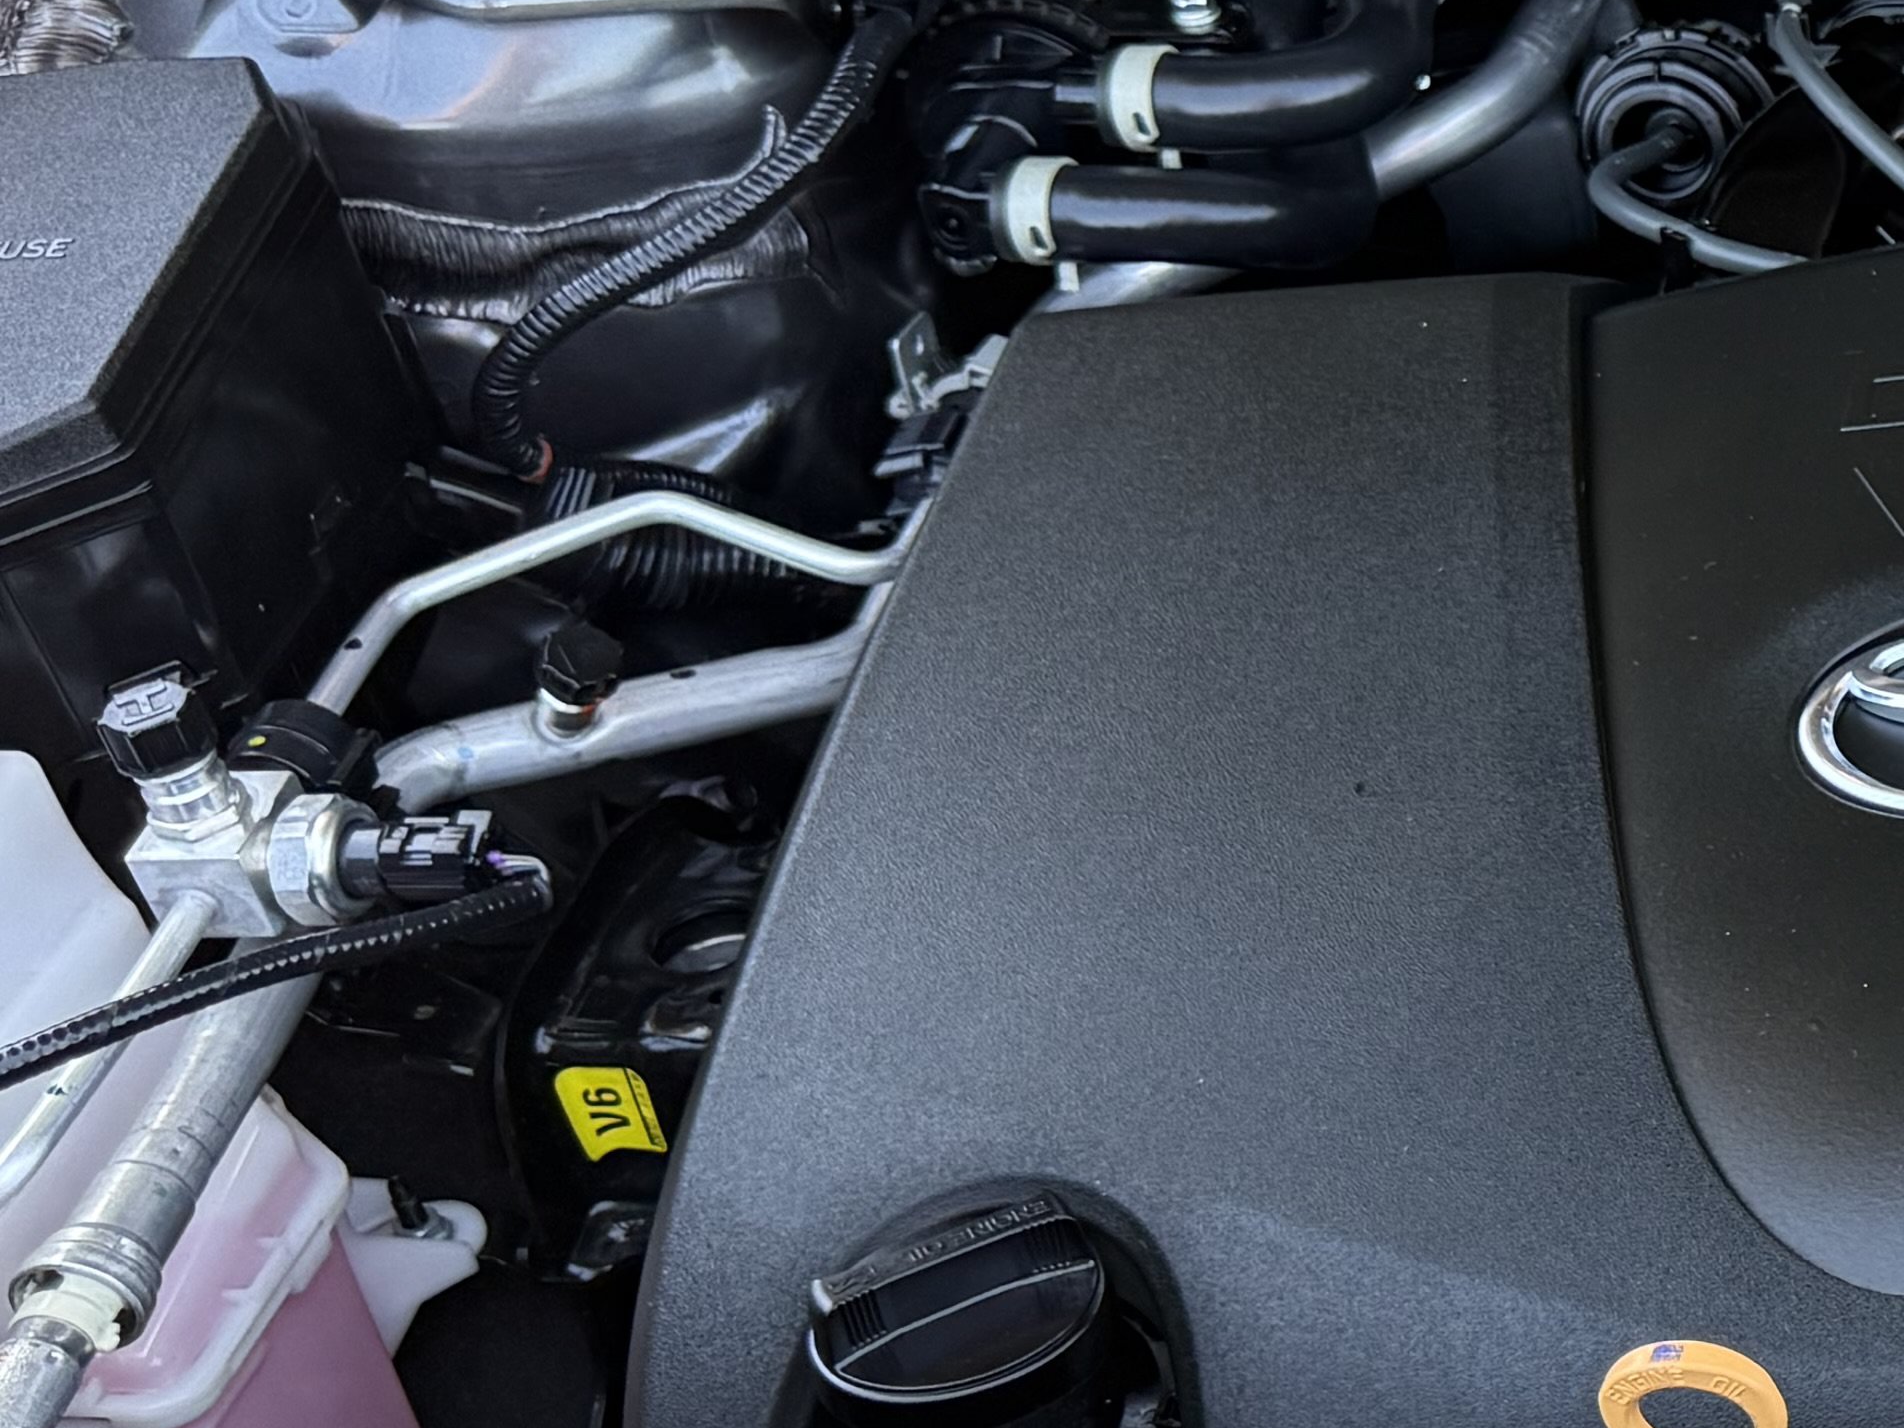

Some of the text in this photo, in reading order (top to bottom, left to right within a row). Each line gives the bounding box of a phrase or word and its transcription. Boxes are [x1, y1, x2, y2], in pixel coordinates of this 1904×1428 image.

[0, 238, 75, 260] USE
[582, 1087, 632, 1137] V6
[1607, 1365, 1685, 1406] ENGINE
